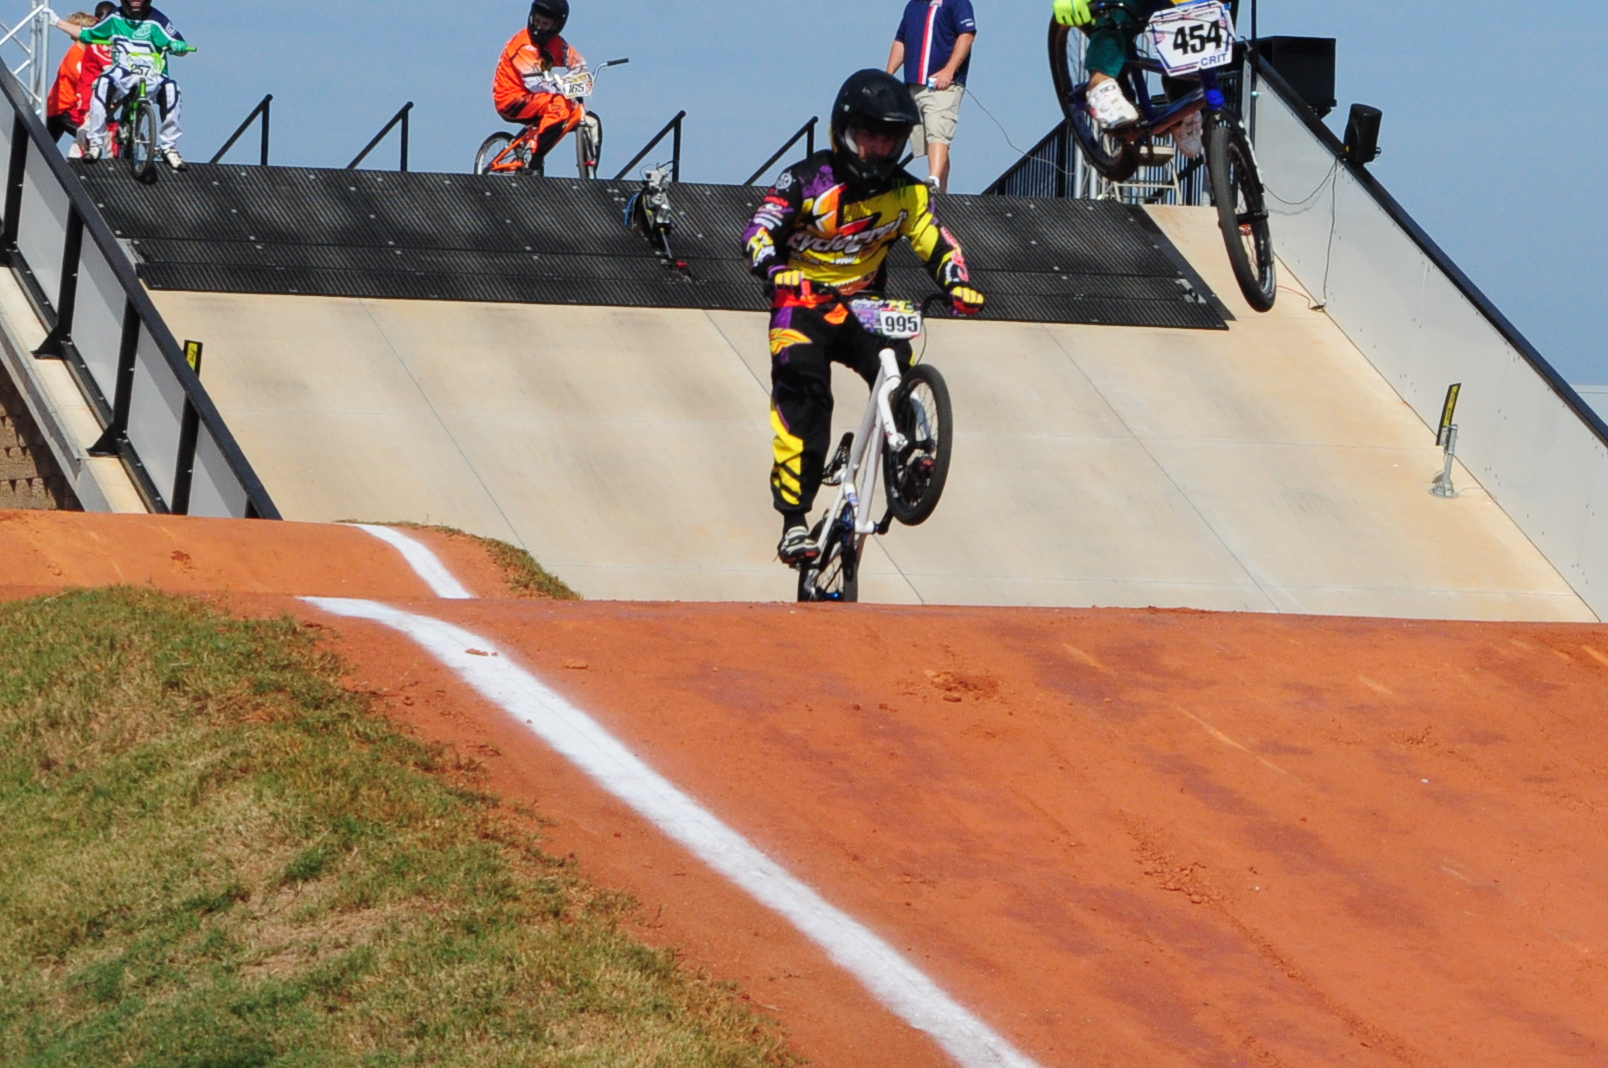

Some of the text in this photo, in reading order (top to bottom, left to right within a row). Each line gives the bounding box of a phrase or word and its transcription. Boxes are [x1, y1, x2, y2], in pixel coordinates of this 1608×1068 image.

[1173, 20, 1222, 55] 454
[1200, 53, 1228, 66] CRIT
[130, 64, 151, 76] 257
[885, 315, 918, 333] 995
